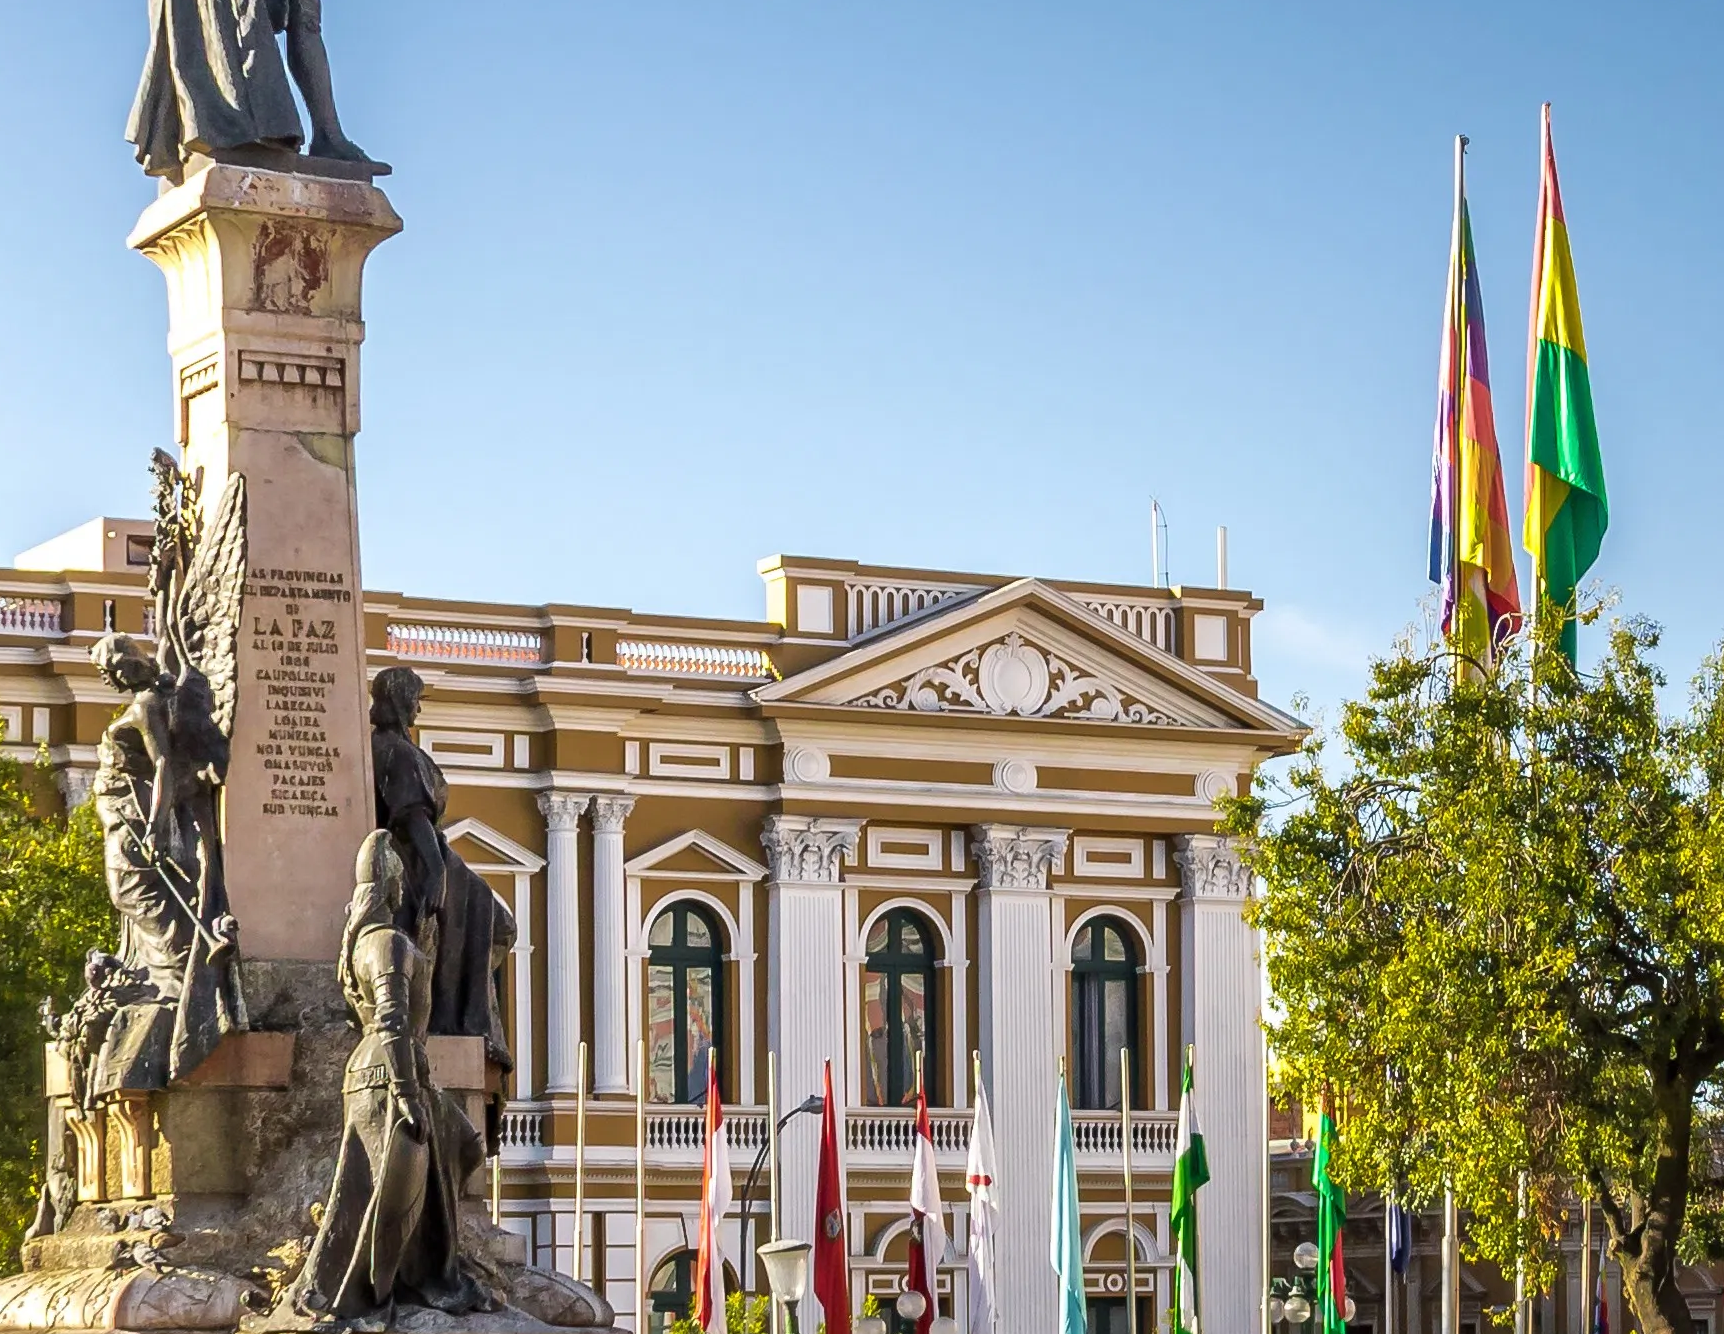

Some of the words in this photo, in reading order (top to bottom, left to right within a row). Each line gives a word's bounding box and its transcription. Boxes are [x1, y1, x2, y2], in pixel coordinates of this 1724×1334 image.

[248, 568, 266, 580] AS
[270, 569, 343, 584] PROVINCIAS
[260, 586, 351, 603] DEPARTAMENTO
[253, 617, 283, 636] LA
[292, 619, 336, 640] PAZ
[252, 639, 268, 650] AL
[287, 641, 302, 653] DE
[306, 642, 339, 654] JULIO
[256, 669, 336, 685] CAUPOLICAN
[273, 774, 326, 786] PACAJES
